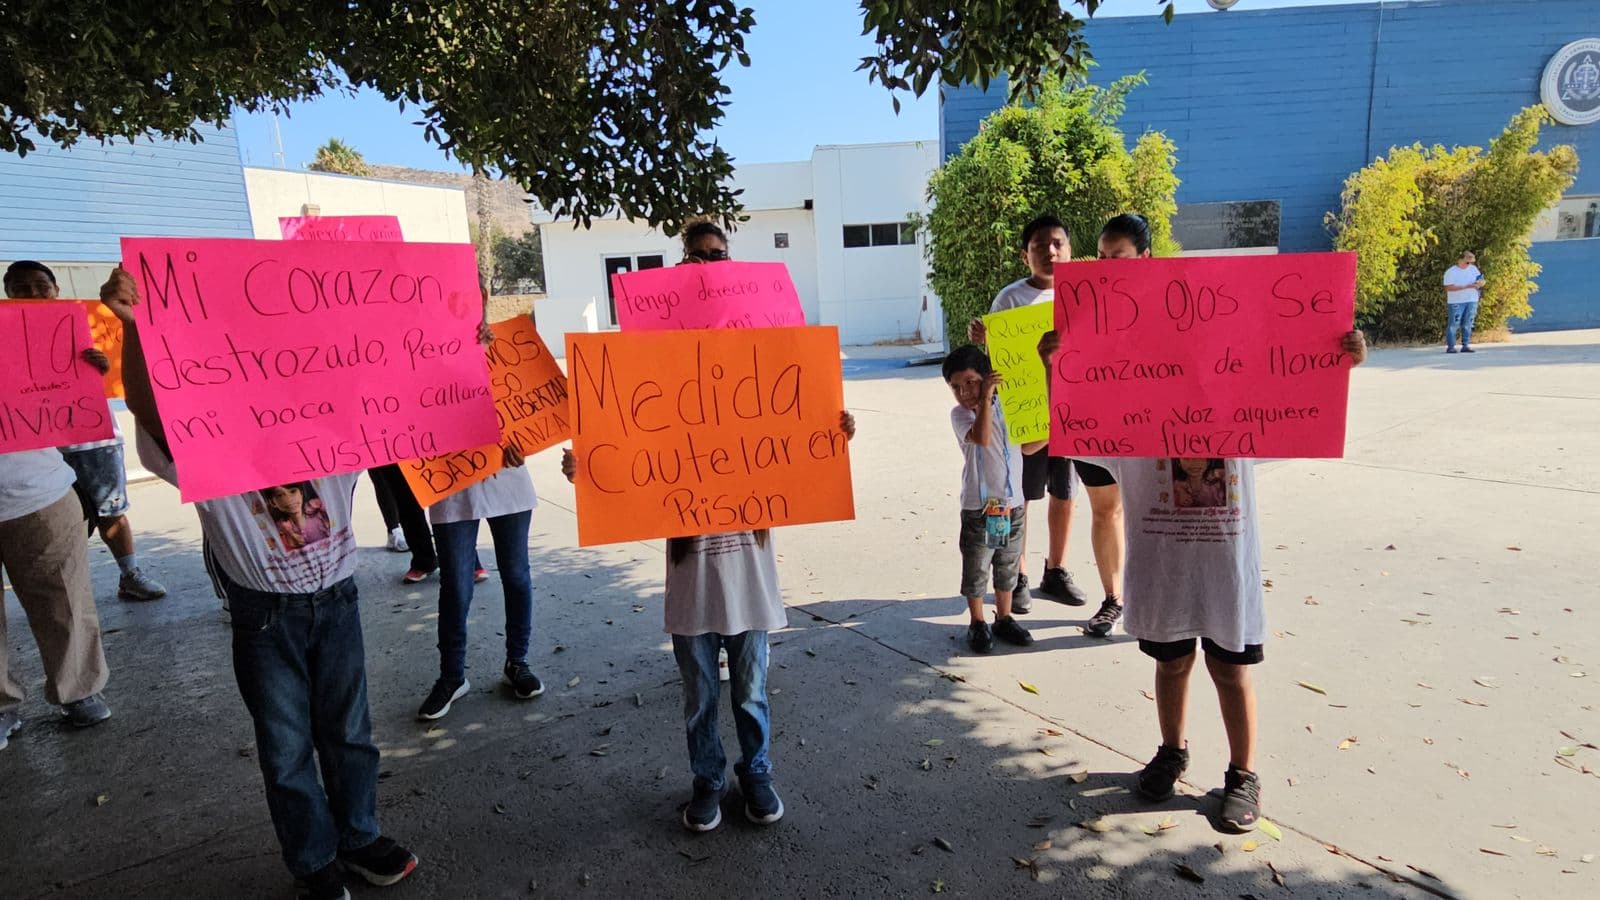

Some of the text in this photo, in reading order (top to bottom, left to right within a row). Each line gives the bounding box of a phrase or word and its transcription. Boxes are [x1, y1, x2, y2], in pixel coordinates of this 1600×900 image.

[139, 251, 442, 325] Mi Corazon
[698, 276, 758, 301] derecho
[773, 280, 783, 293] a
[1058, 276, 1139, 335] Mis
[1271, 273, 1336, 318] Se
[152, 328, 462, 390] destrozado, Pero
[1058, 345, 1349, 383] Canzaron de llorar
[170, 383, 489, 443] mi boca no callara
[573, 341, 802, 437] Medida
[1054, 402, 1098, 435] Pero
[1123, 408, 1151, 426] mi
[1161, 418, 1256, 457] fuerza
[288, 424, 437, 474] Justicia
[420, 449, 487, 493] BAJO
[588, 429, 848, 493] Cautelar en
